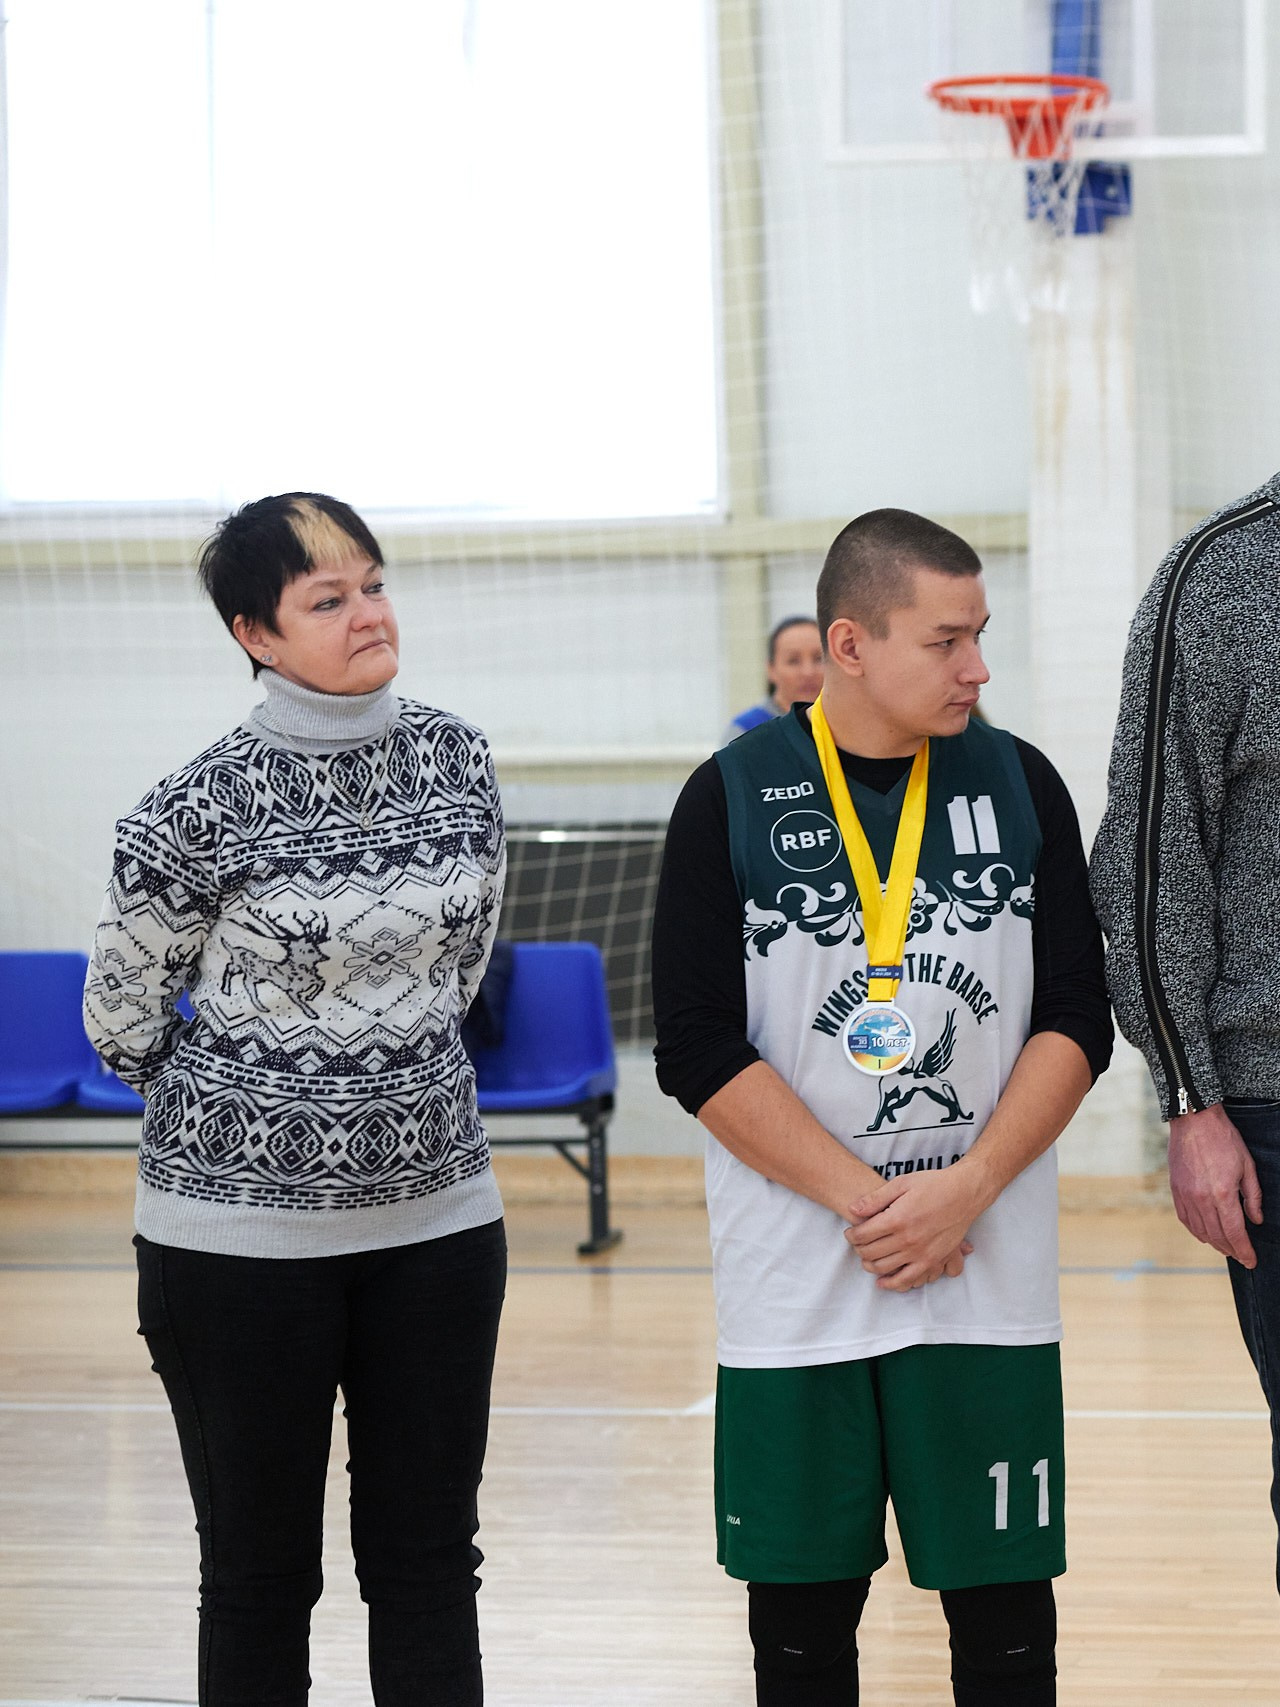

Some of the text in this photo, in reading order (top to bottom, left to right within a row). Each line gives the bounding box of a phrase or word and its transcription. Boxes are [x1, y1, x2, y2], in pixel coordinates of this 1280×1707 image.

[780, 828, 832, 852] RBF
[946, 794, 1001, 855] 11
[811, 970, 869, 1037] WINGS
[905, 953, 946, 985] THE
[945, 961, 999, 1025] BARSE
[871, 1035, 885, 1047] 10
[988, 1458, 1050, 1531] 11
